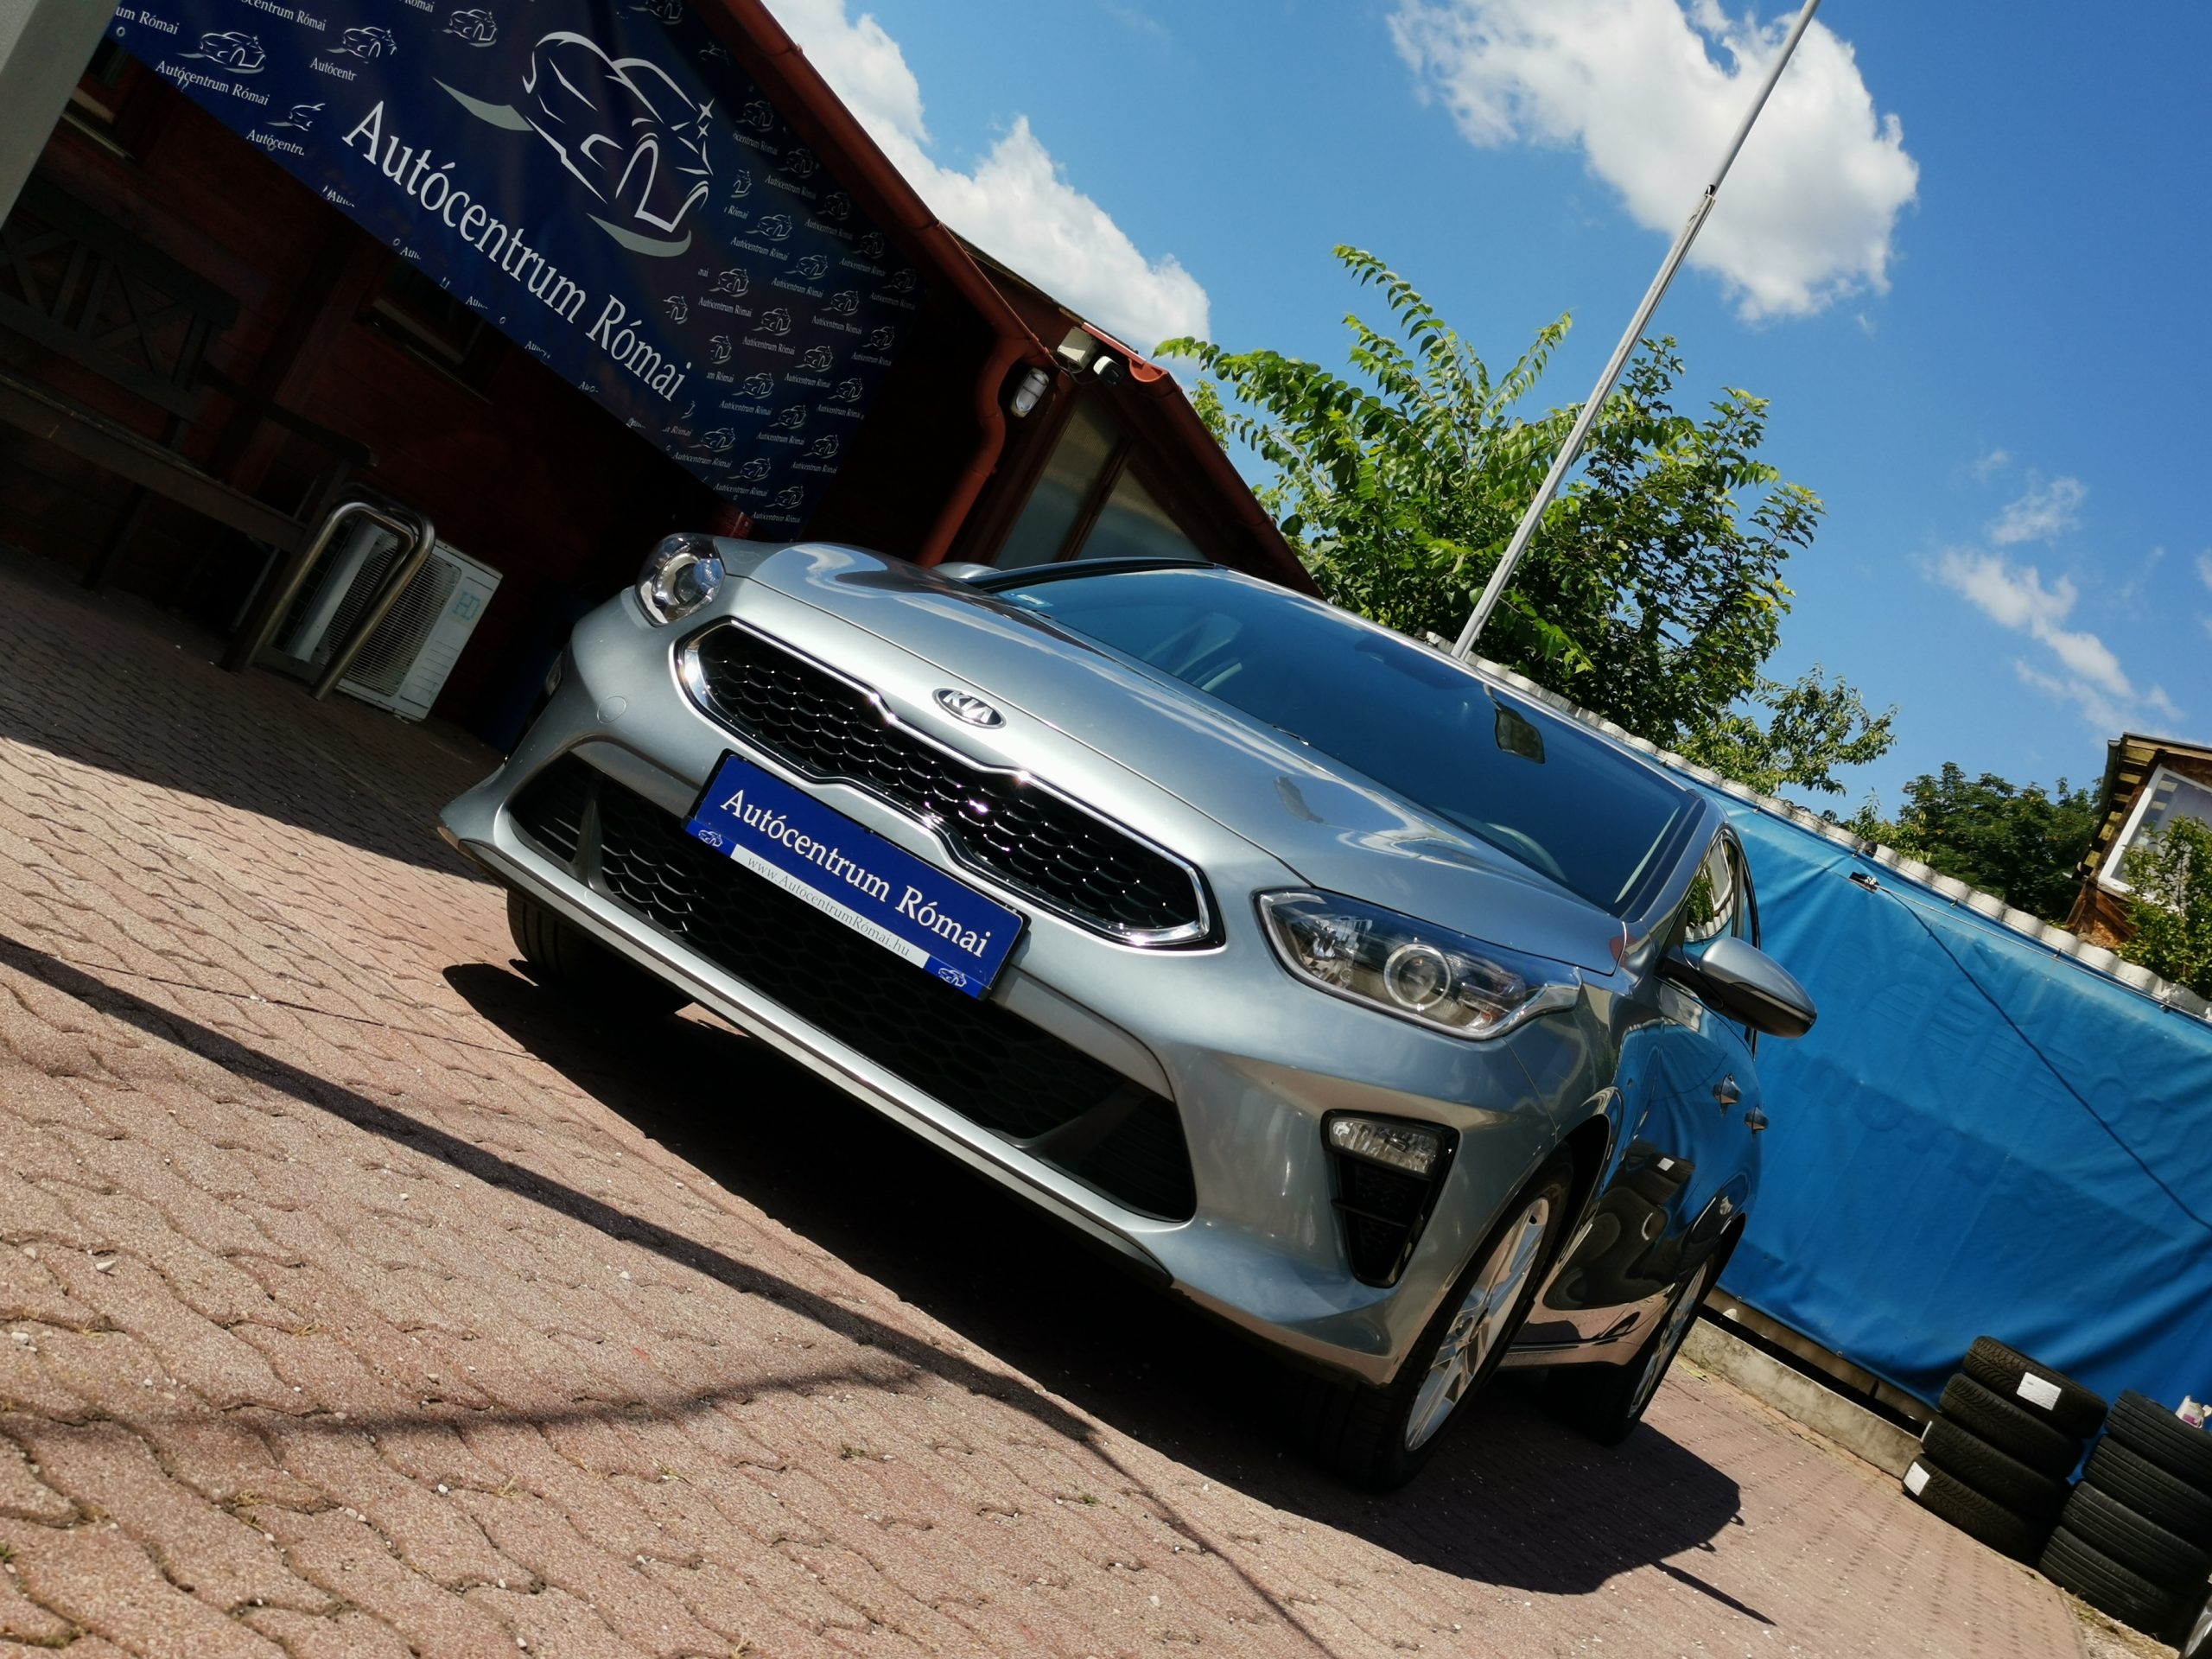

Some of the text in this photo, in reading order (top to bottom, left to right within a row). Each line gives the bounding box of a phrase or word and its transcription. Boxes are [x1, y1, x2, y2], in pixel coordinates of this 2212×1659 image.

[139, 10, 180, 35] Római
[296, 10, 327, 32] Római
[155, 60, 270, 106] Autócentrum Római
[341, 100, 692, 402] Autócentrum Római
[720, 789, 991, 958] Autócentrum Római
[747, 856, 910, 957] www.AutócentrumRómai.hu
